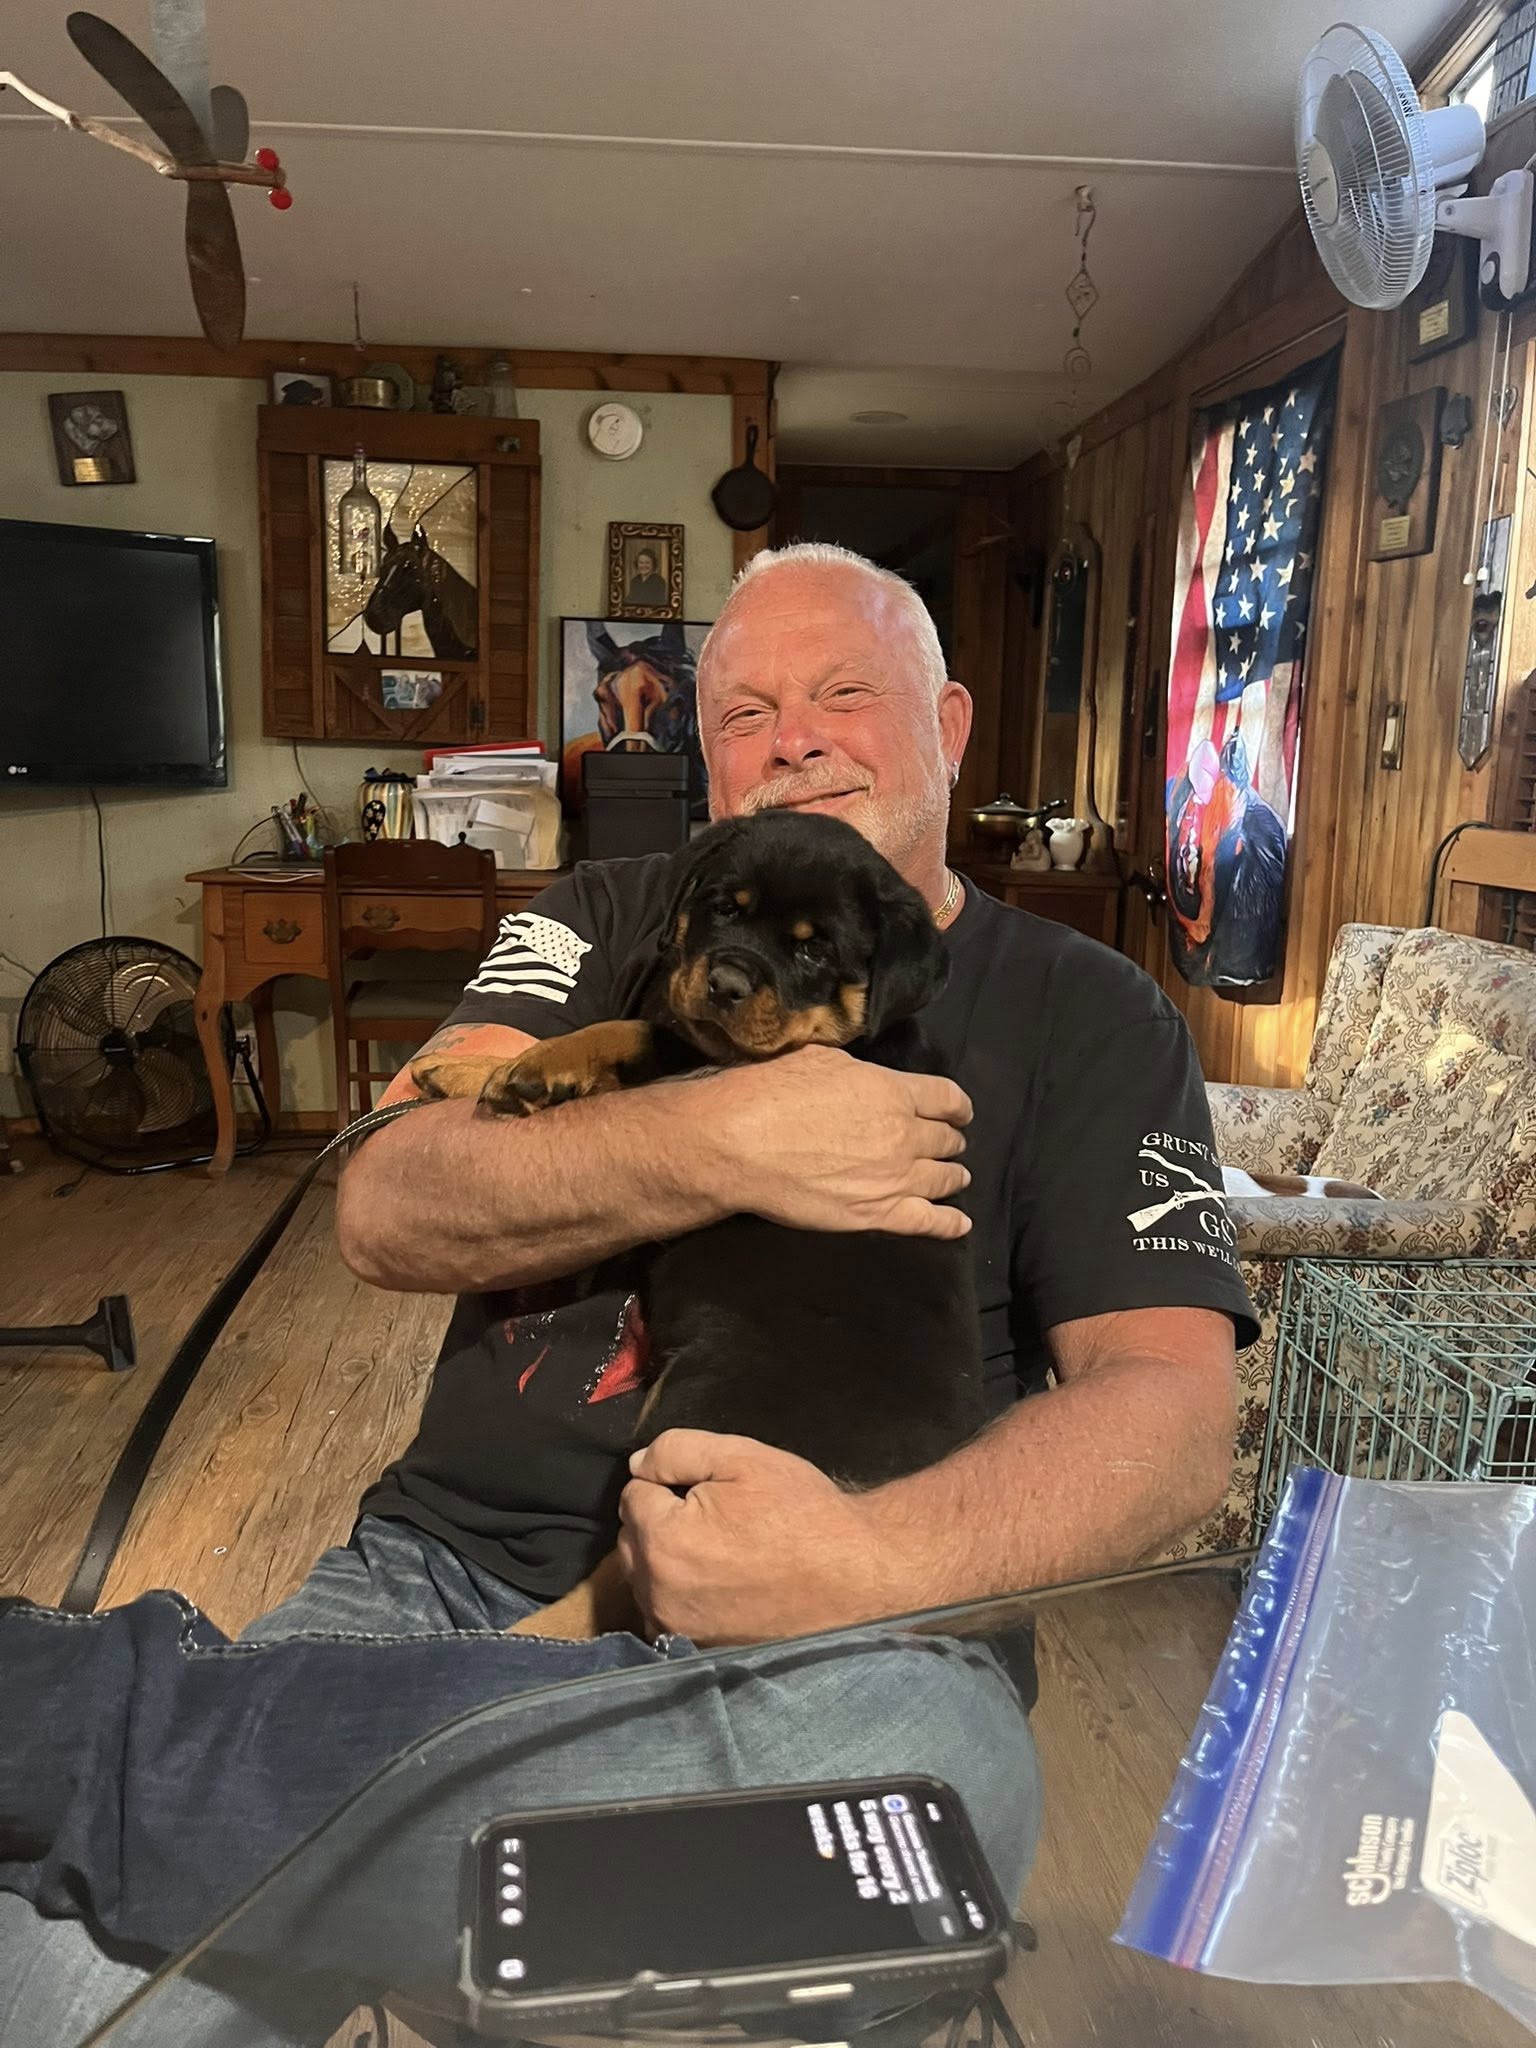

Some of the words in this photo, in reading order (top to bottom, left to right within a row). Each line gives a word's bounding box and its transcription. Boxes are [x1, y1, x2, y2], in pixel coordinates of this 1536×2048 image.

[1142, 1132, 1209, 1161] GRUNT
[1139, 1170, 1169, 1188] US
[1133, 1237, 1189, 1251] THIS
[1192, 1240, 1232, 1265] WE'LL
[833, 1801, 862, 1851] weeks
[847, 1850, 869, 1876] for
[858, 1799, 878, 1812] 5
[888, 1889, 911, 1905] 2
[1446, 1831, 1489, 1896] Ziploc
[856, 1876, 881, 1899] 16
